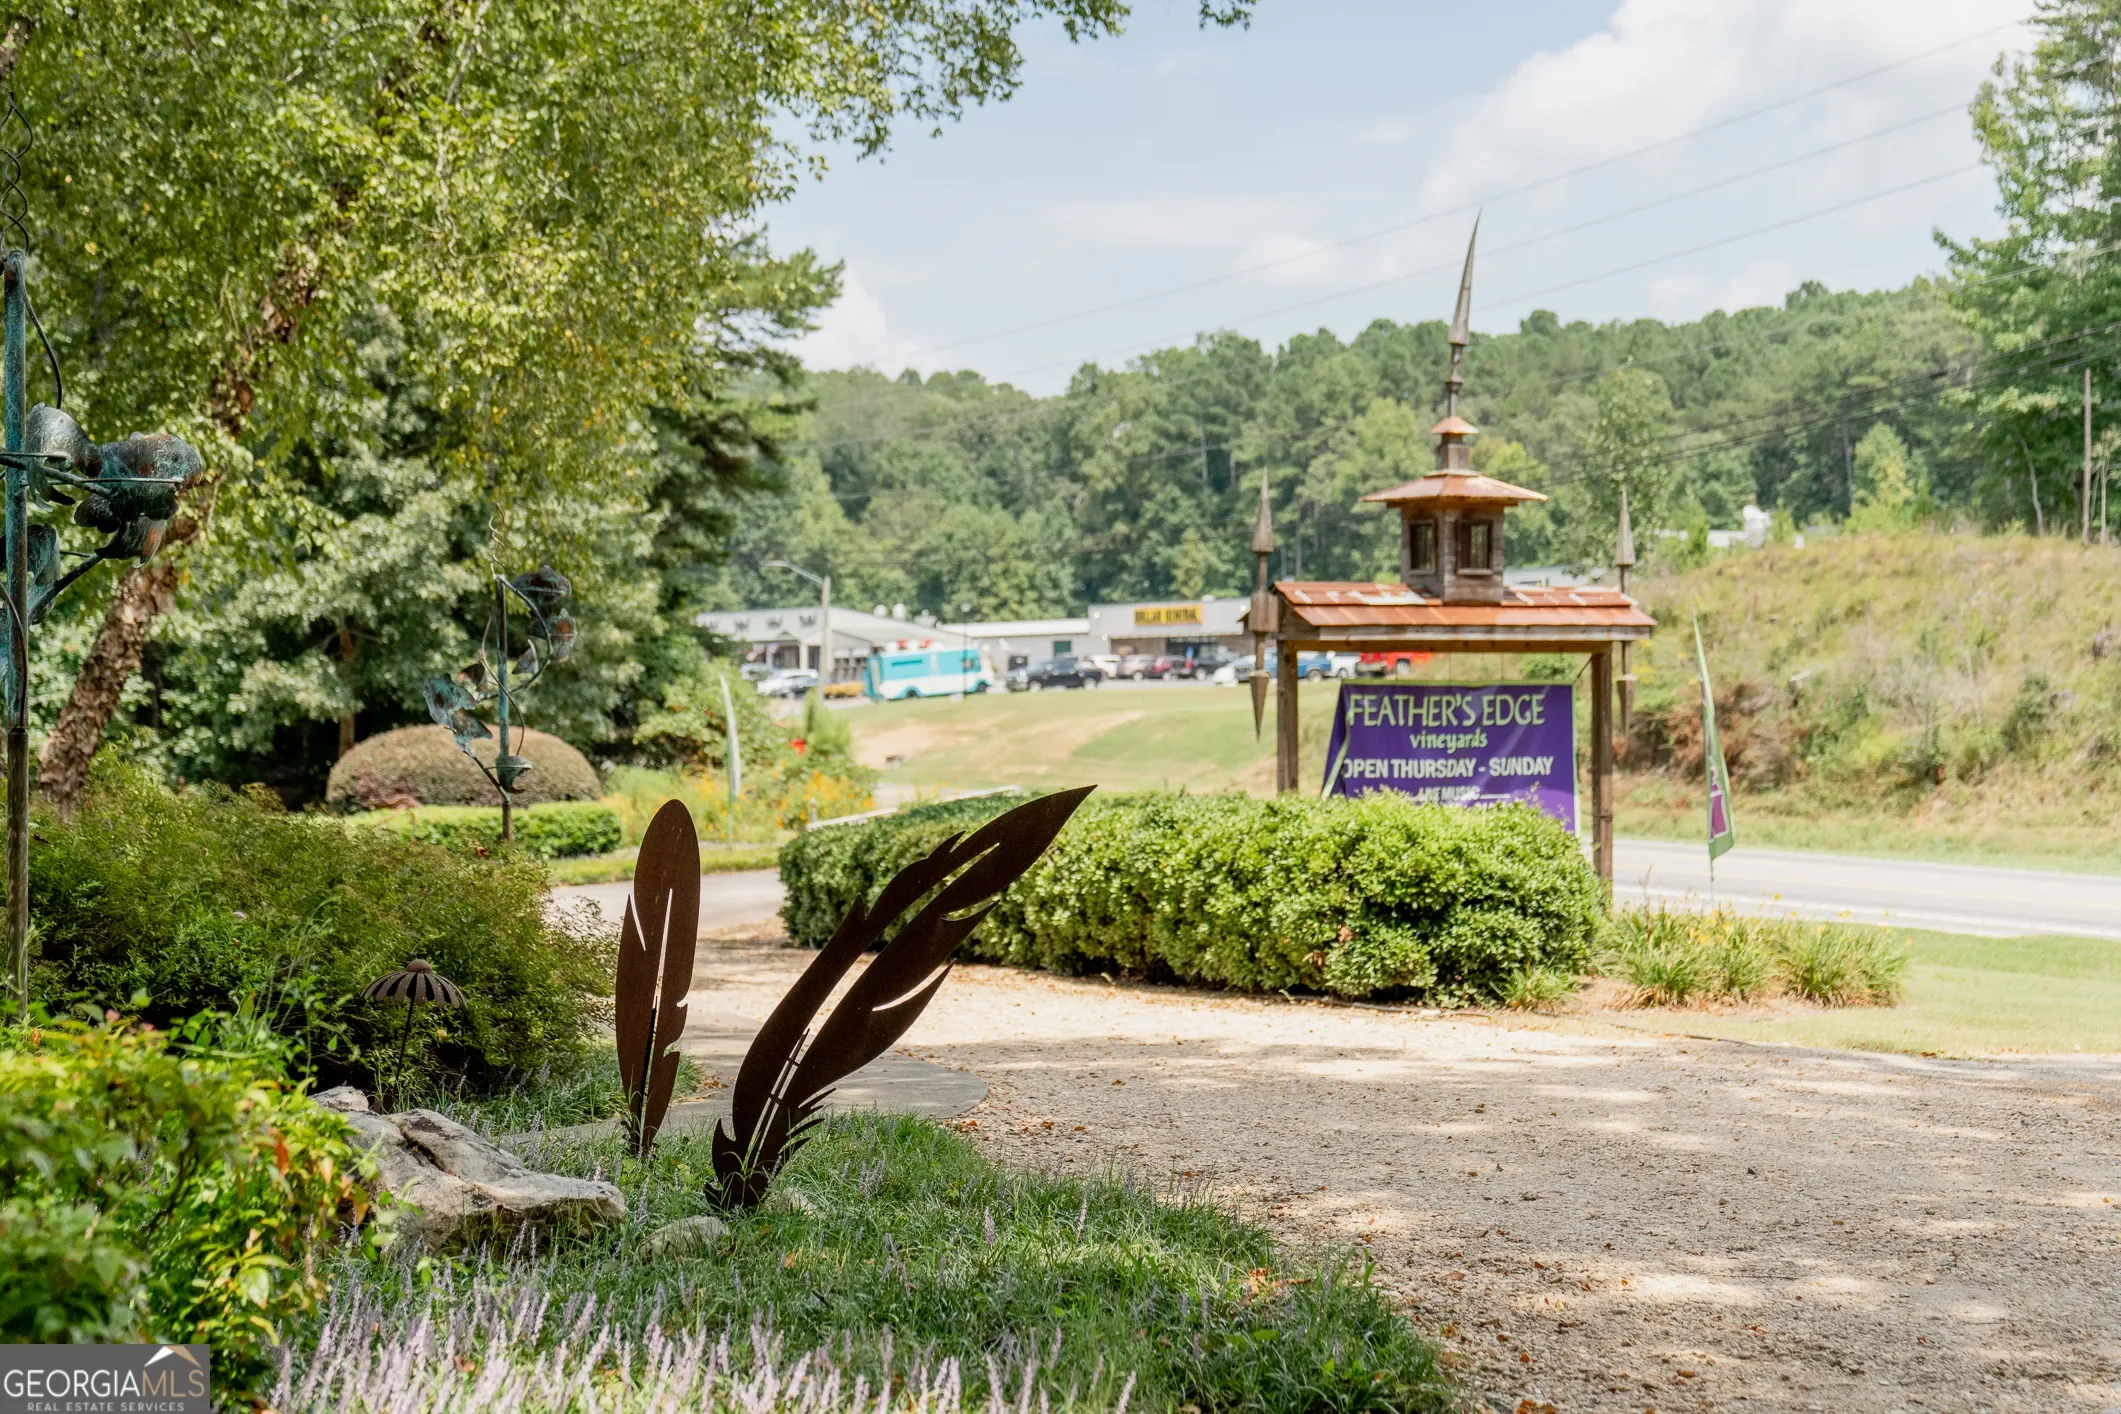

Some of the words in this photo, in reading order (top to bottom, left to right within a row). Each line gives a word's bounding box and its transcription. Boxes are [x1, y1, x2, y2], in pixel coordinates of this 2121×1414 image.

[1348, 693, 1477, 727] FEATHER'S
[1482, 692, 1545, 726] EDGE
[1409, 728, 1489, 754] vineyards
[1391, 757, 1477, 779] THURSDAY
[1489, 755, 1554, 777] SUNDAY
